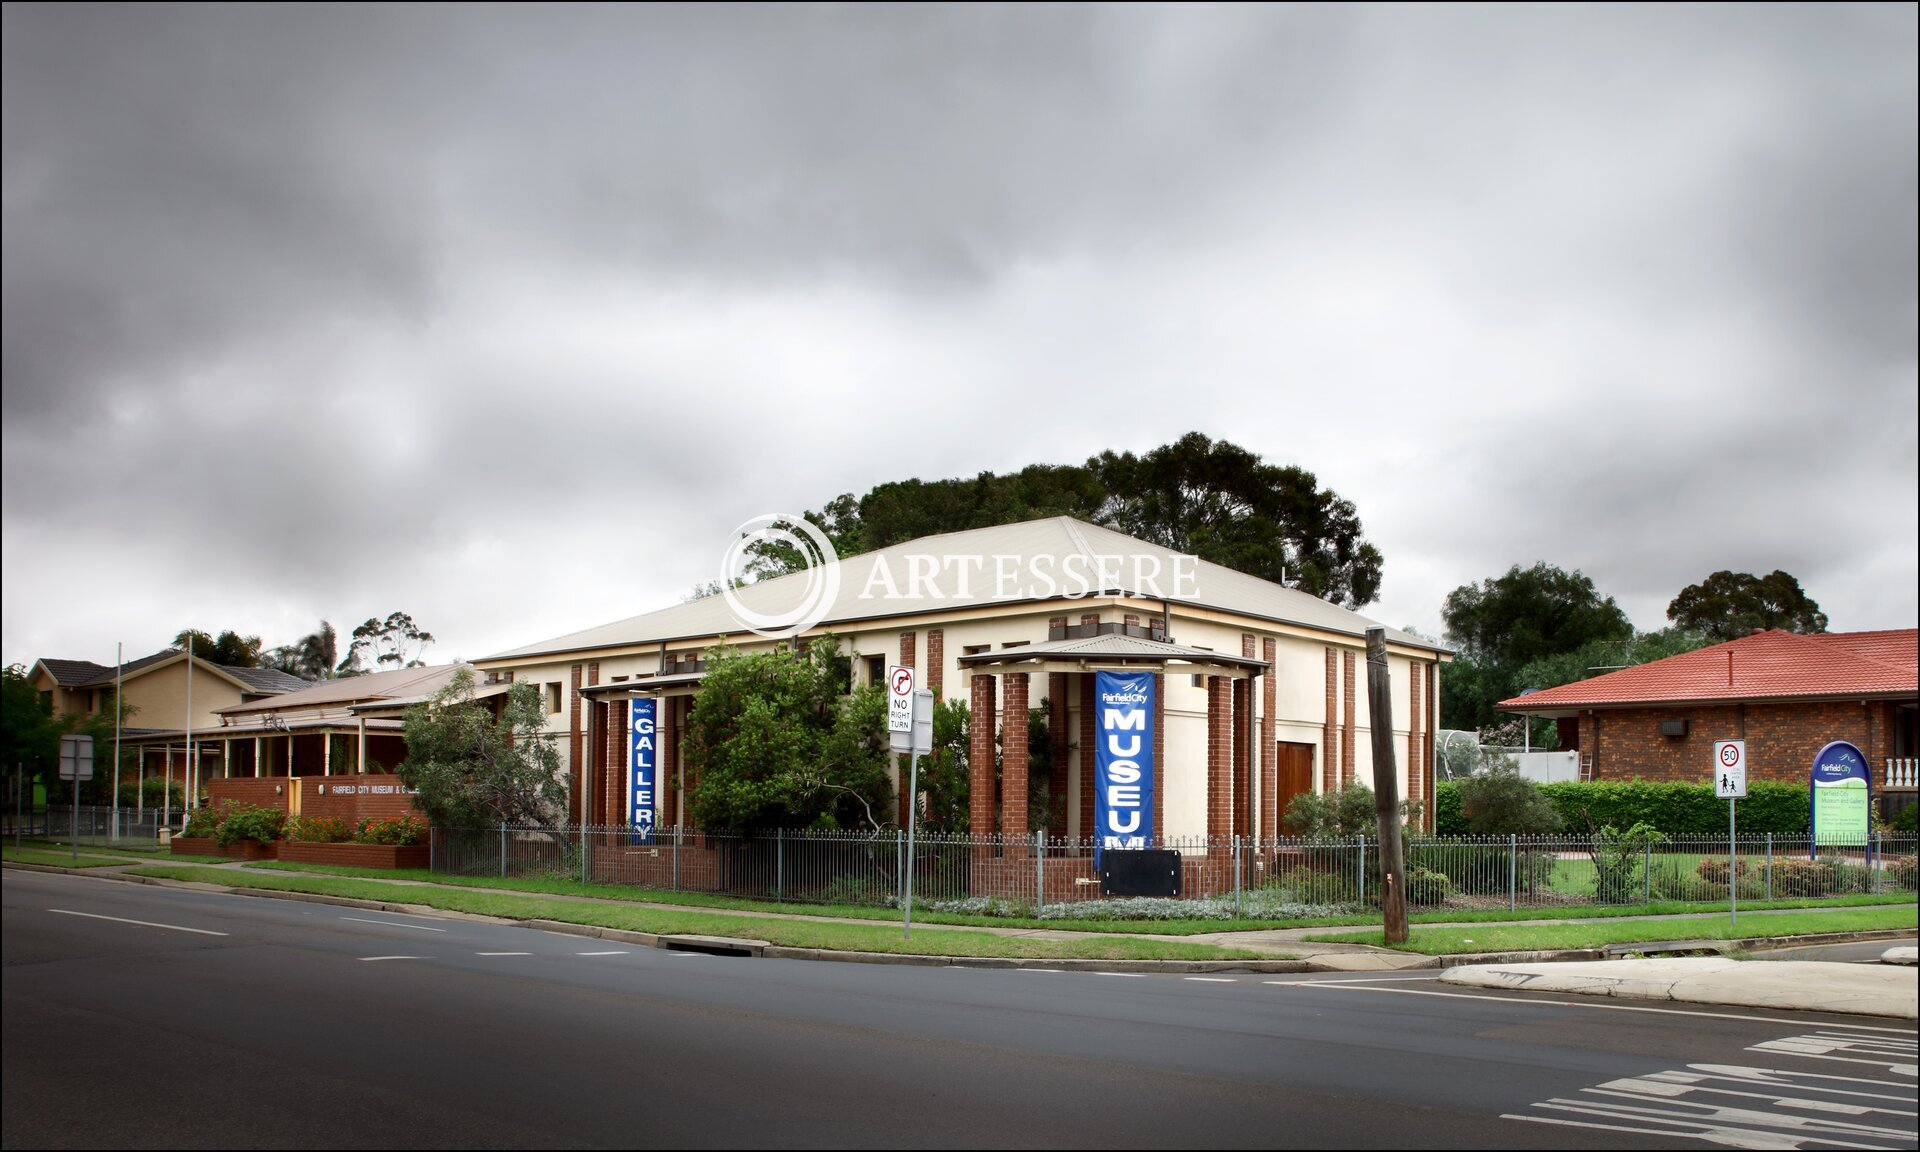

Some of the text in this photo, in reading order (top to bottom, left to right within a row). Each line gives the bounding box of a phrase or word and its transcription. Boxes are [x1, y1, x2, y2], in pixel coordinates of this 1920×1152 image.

[893, 699, 908, 710] NO
[890, 711, 910, 720] RIGHT
[890, 720, 909, 729] TURN
[1724, 750, 1736, 761] 50
[332, 785, 356, 794] FAIRFIELD
[358, 785, 370, 794] CITY
[371, 785, 394, 794] MUSEUM
